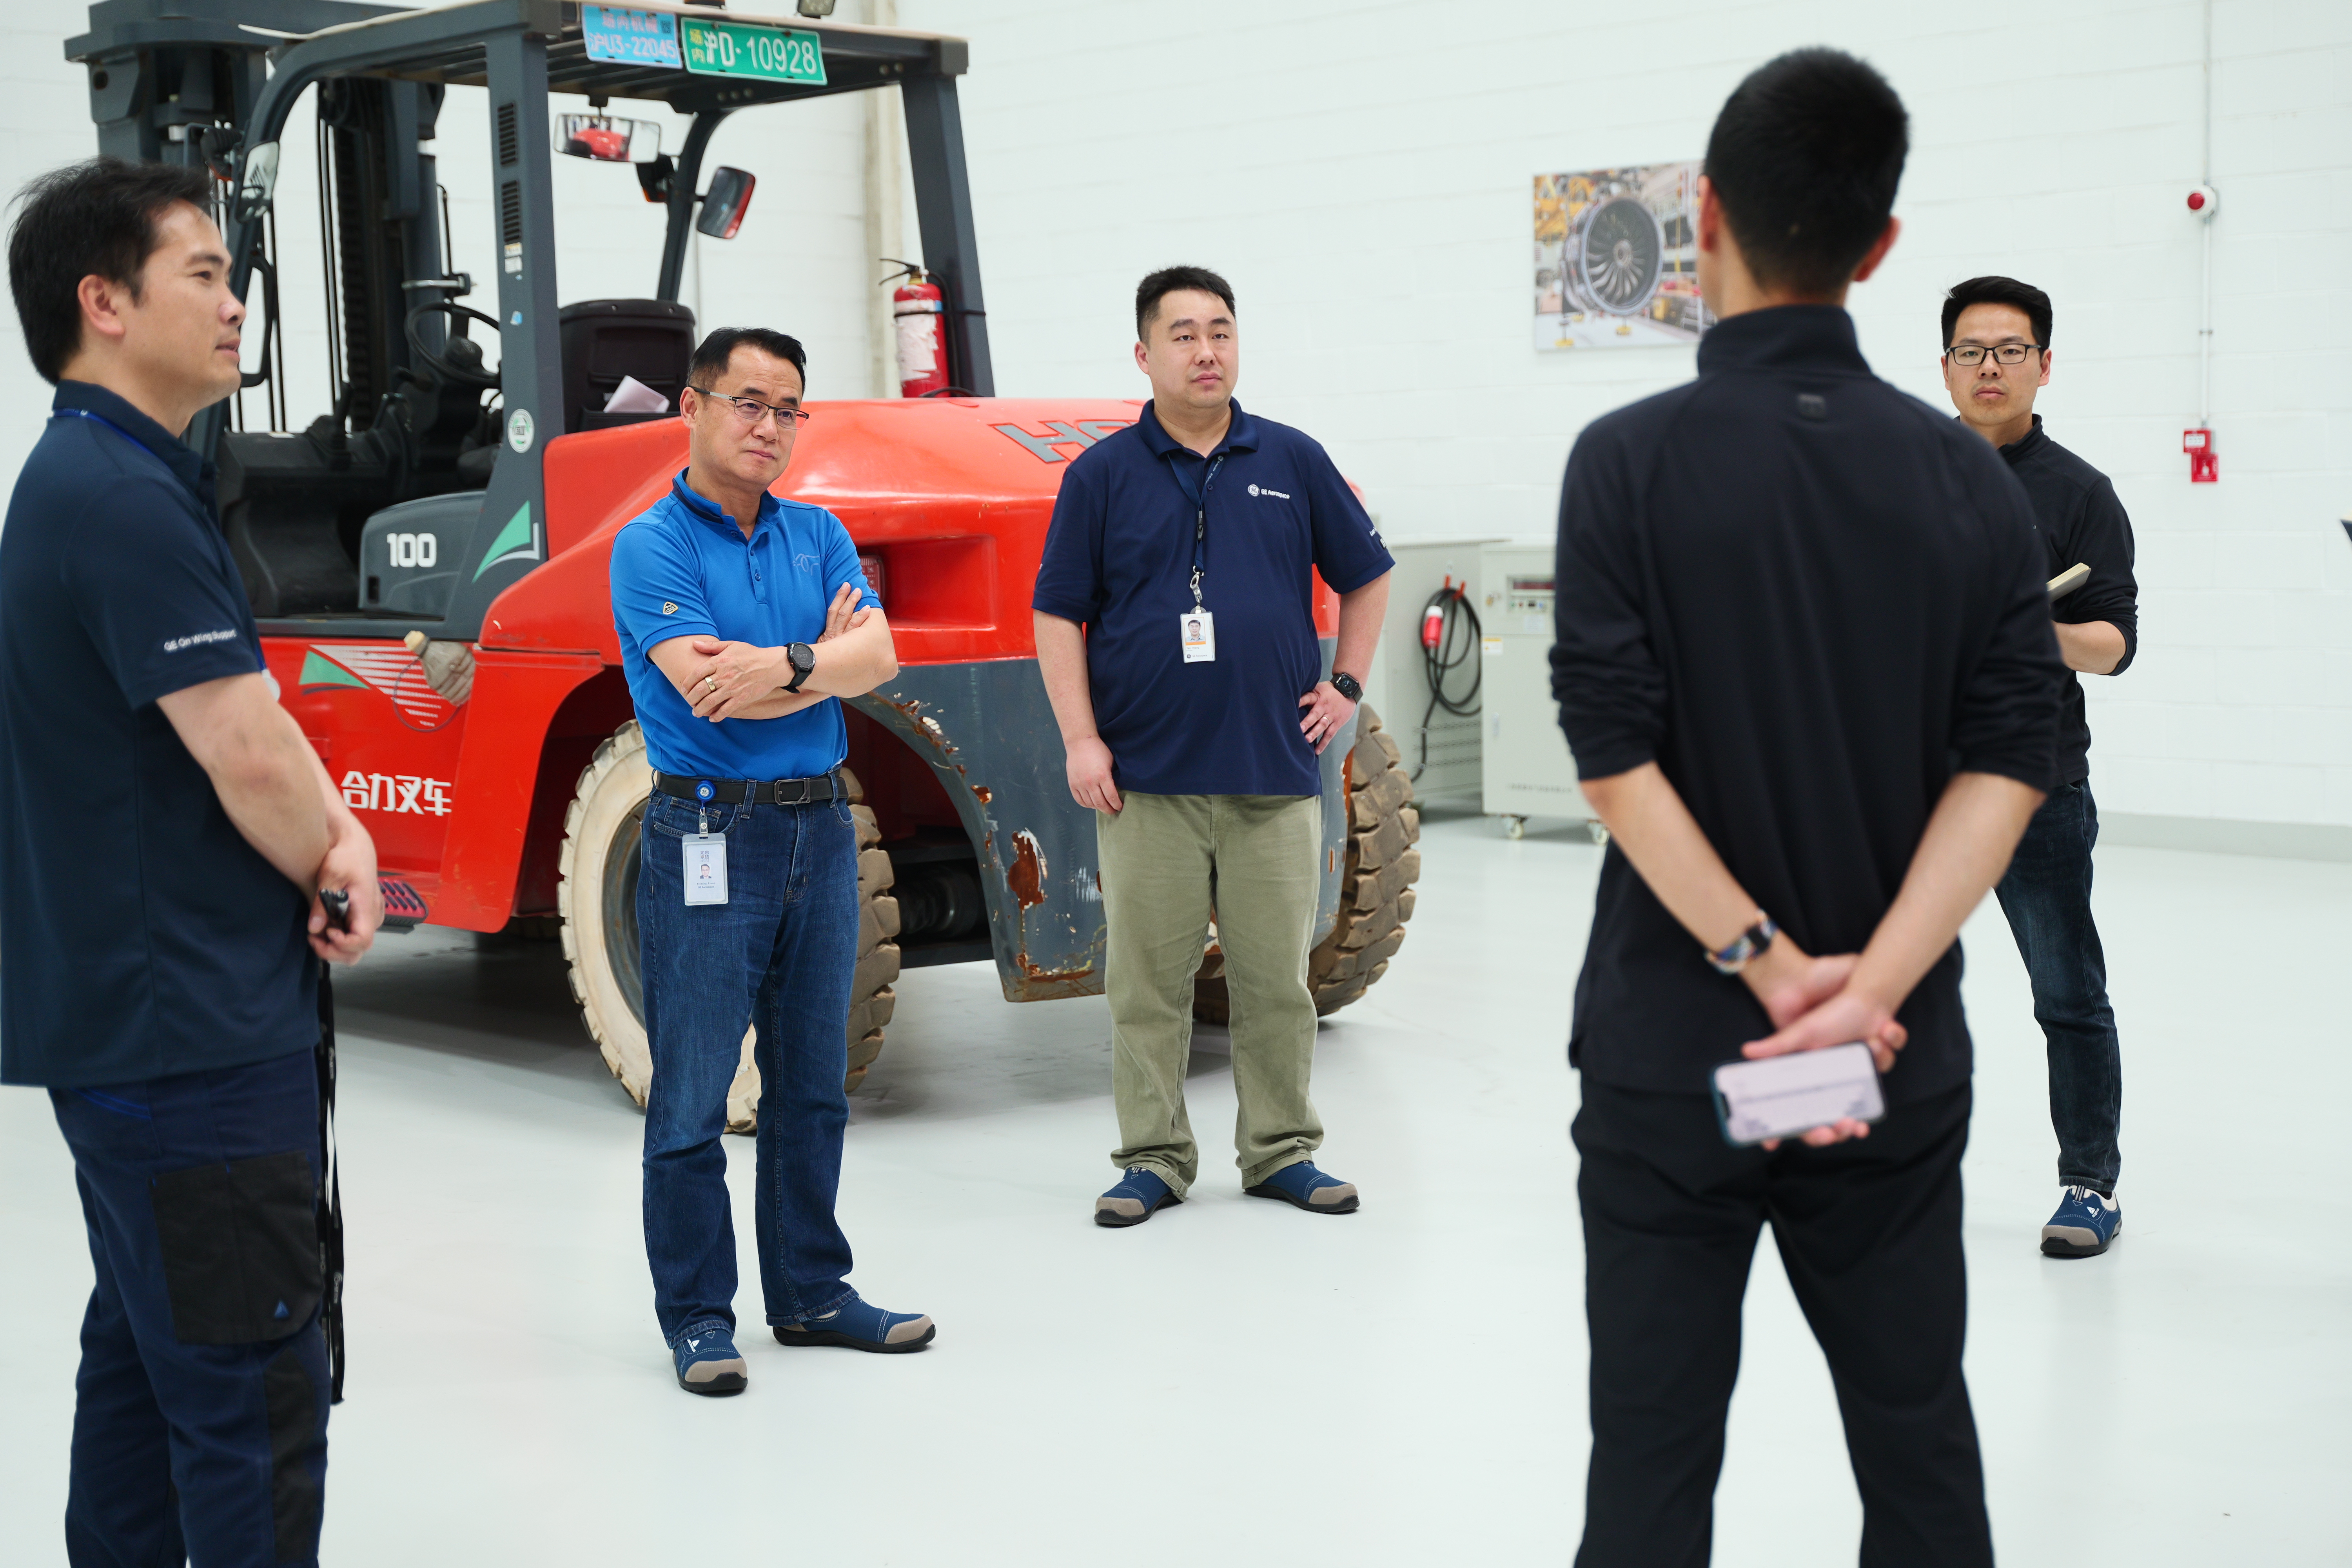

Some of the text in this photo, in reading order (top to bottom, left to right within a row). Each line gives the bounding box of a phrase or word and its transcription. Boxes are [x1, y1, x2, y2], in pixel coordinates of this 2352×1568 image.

[1268, 489, 1290, 499] Aerospace
[387, 533, 437, 568] 100
[340, 770, 452, 817] 合力叉车
